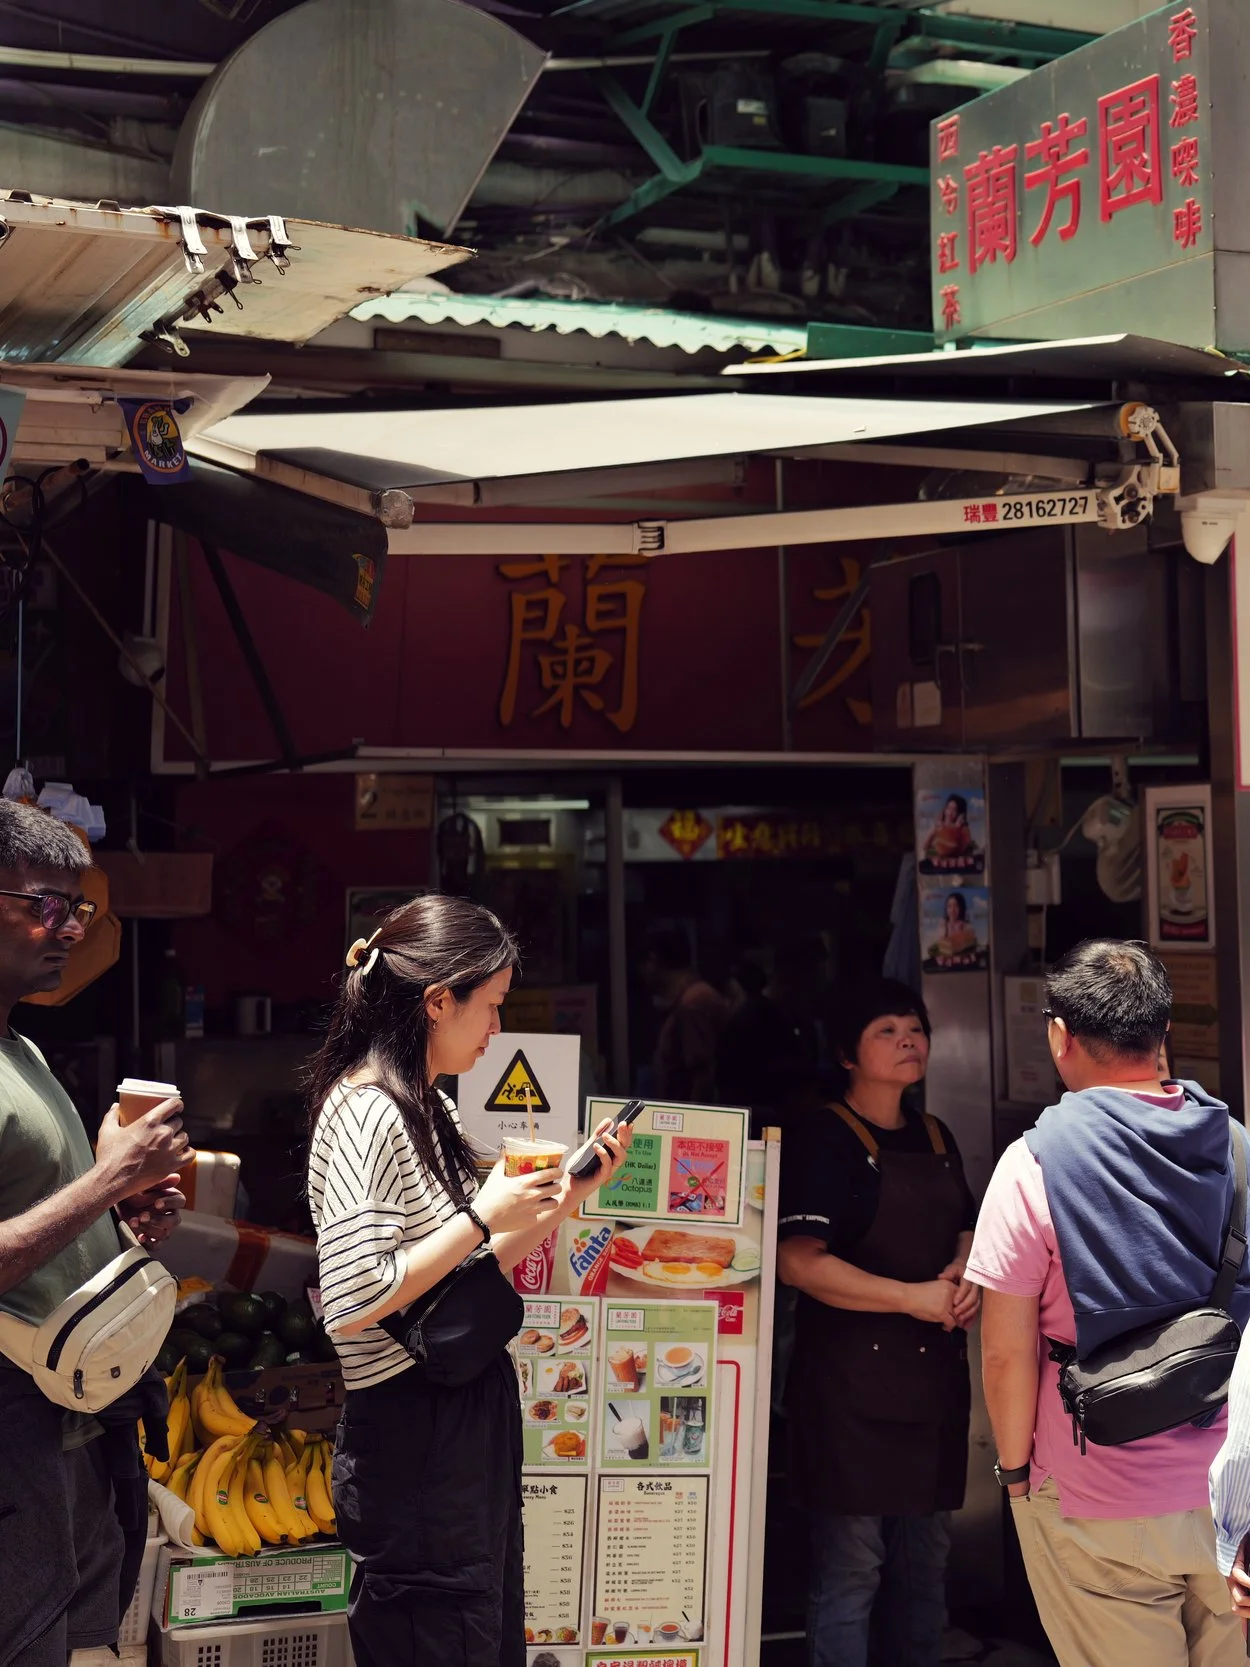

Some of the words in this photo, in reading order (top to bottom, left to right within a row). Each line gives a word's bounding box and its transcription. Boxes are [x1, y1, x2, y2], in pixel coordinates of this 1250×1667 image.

[963, 73, 1164, 276] 蘭芳園
[936, 114, 961, 330] 西冷紅茶
[144, 450, 182, 468] MARKET
[963, 502, 998, 524] 瑞豐
[1002, 497, 1088, 521] 28162727
[677, 1140, 724, 1153] 本店不接受
[621, 1184, 652, 1193] Octopus
[570, 1227, 612, 1277] Fanta
[637, 1481, 672, 1491] 各式飲品
[262, 1559, 273, 1567] OF
[275, 1558, 312, 1566] PRODUCE
[233, 1591, 275, 1599] AVOCADOS
[277, 1589, 325, 1597] AUSTRALIAN
[184, 1607, 196, 1617] 28
